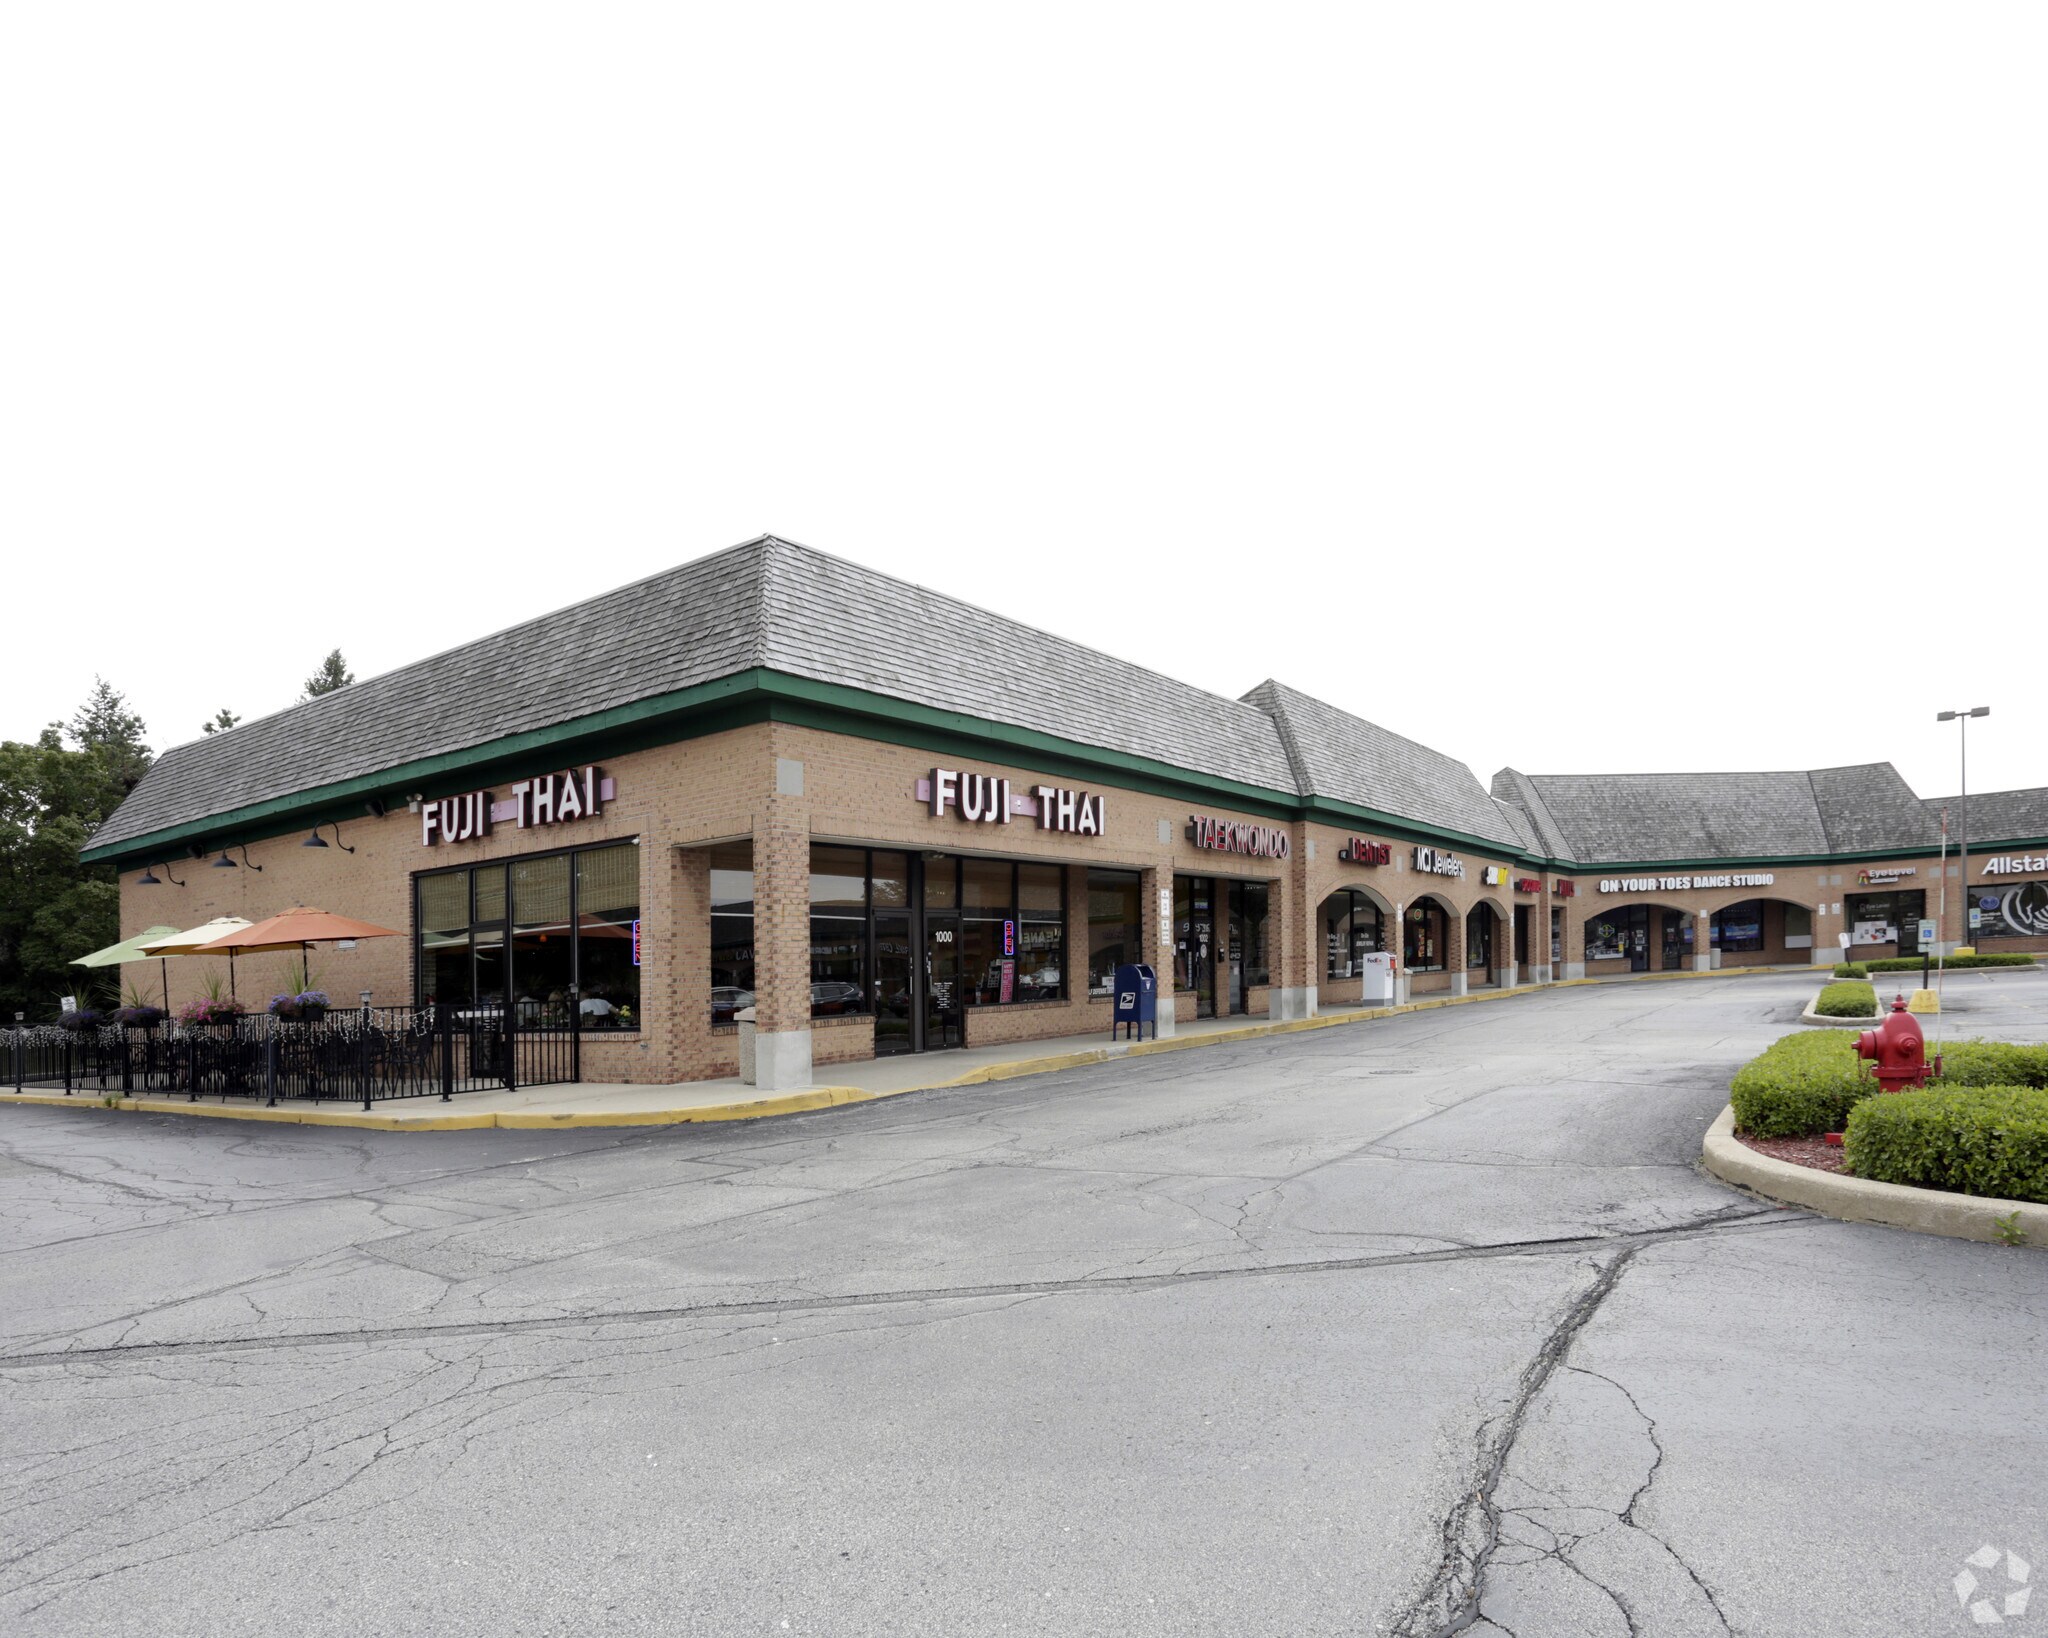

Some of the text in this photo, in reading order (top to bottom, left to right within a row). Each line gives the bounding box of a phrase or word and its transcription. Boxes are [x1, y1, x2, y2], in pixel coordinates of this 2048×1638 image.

[421, 765, 598, 847] FUJI THAI
[933, 767, 1106, 836] FUJI THAI
[1193, 814, 1290, 860] TAEKWONDO
[1351, 836, 1393, 865] DENTIST
[1432, 849, 1463, 878] Jewelers
[1868, 865, 1917, 879] Eye Level
[1599, 873, 1775, 894] ON YOUR TOES DANCE STUDIO
[935, 930, 953, 943] 1000
[1005, 923, 1013, 953] OPEN
